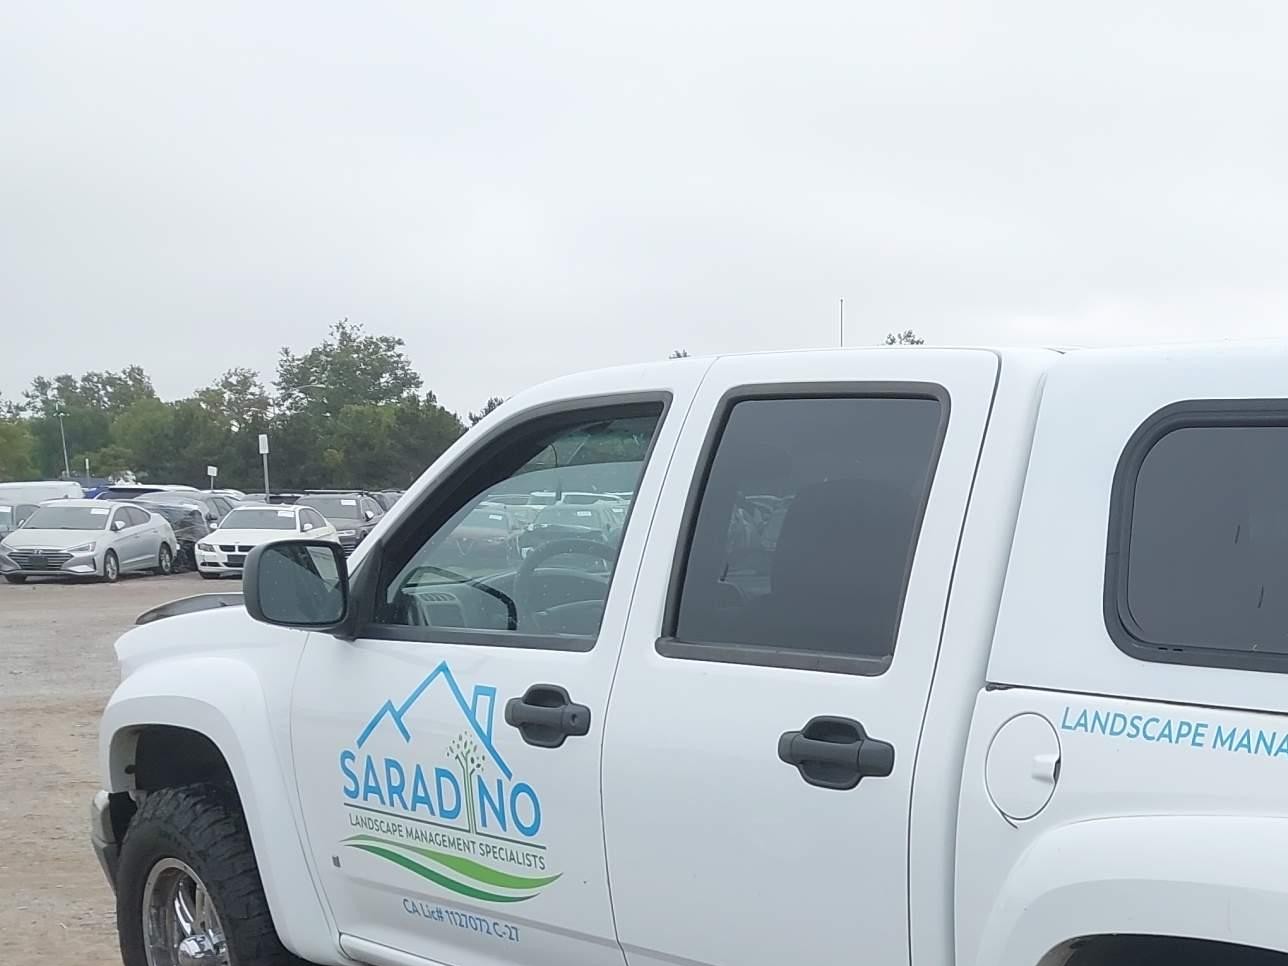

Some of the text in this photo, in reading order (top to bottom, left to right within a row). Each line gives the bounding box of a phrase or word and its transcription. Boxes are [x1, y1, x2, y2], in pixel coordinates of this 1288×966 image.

[1060, 706, 1209, 748] LANDSCAPE
[339, 749, 542, 838] SARADINO
[348, 813, 547, 871] LANDSCAPE MANAGEMENT SPECIALISTS
[402, 898, 520, 942] CA Lic# 1127072 C-27
